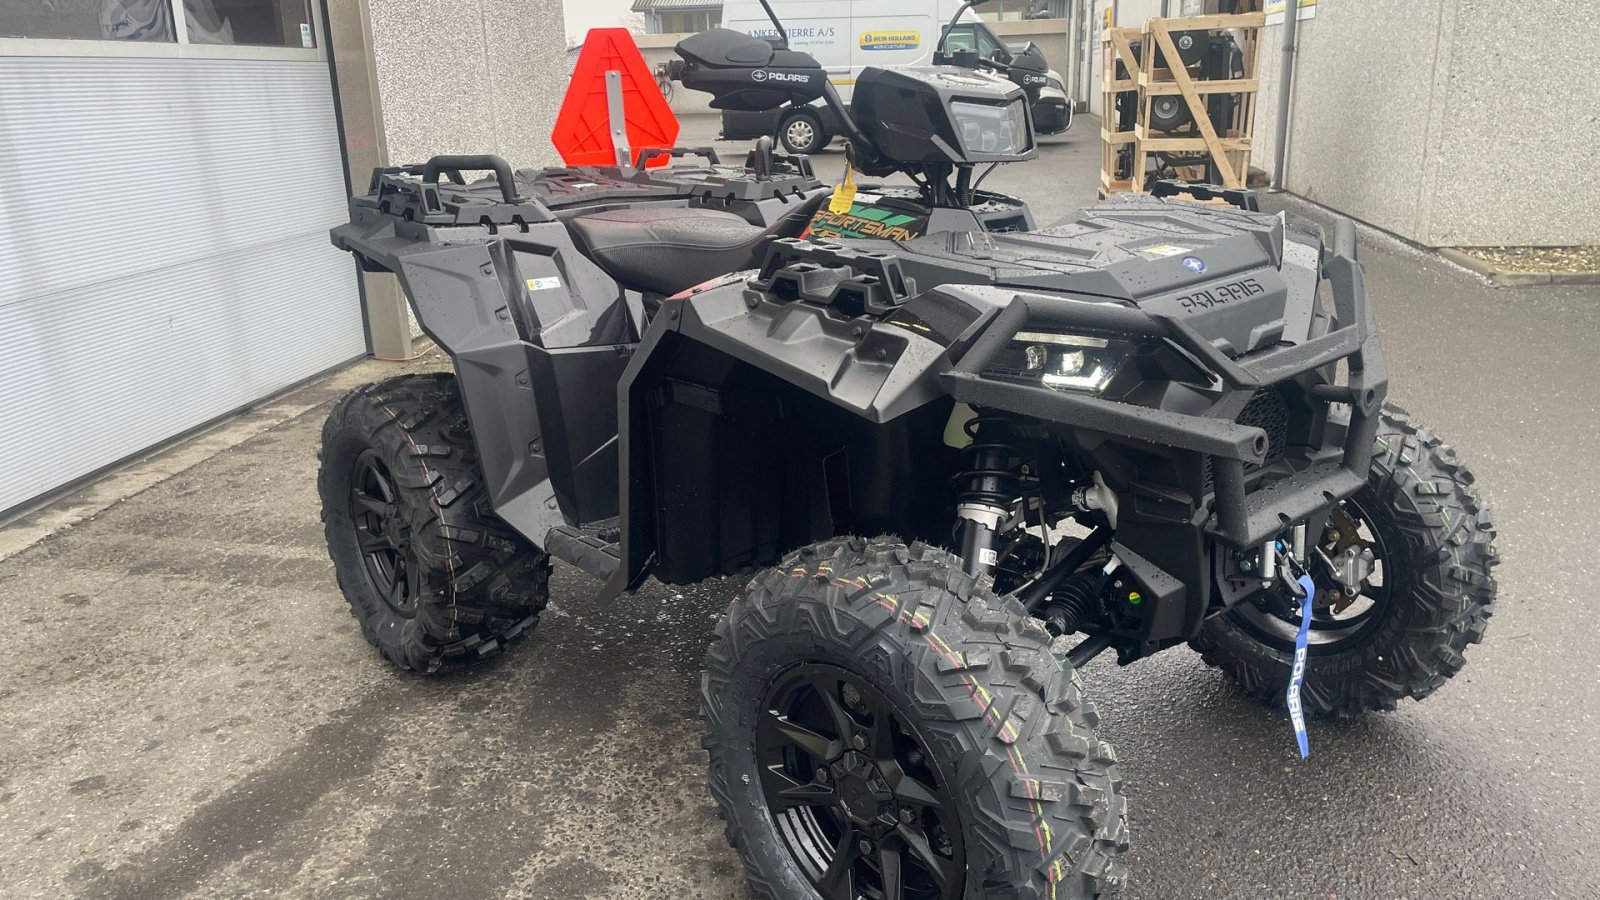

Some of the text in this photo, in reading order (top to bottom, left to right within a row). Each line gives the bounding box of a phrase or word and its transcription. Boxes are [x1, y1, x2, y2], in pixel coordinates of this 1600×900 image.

[747, 27, 835, 39] ANKER JERRE A/S
[768, 72, 810, 83] POLARIS
[1176, 278, 1265, 314] POLARIS
[1289, 647, 1307, 733] POLARIS
